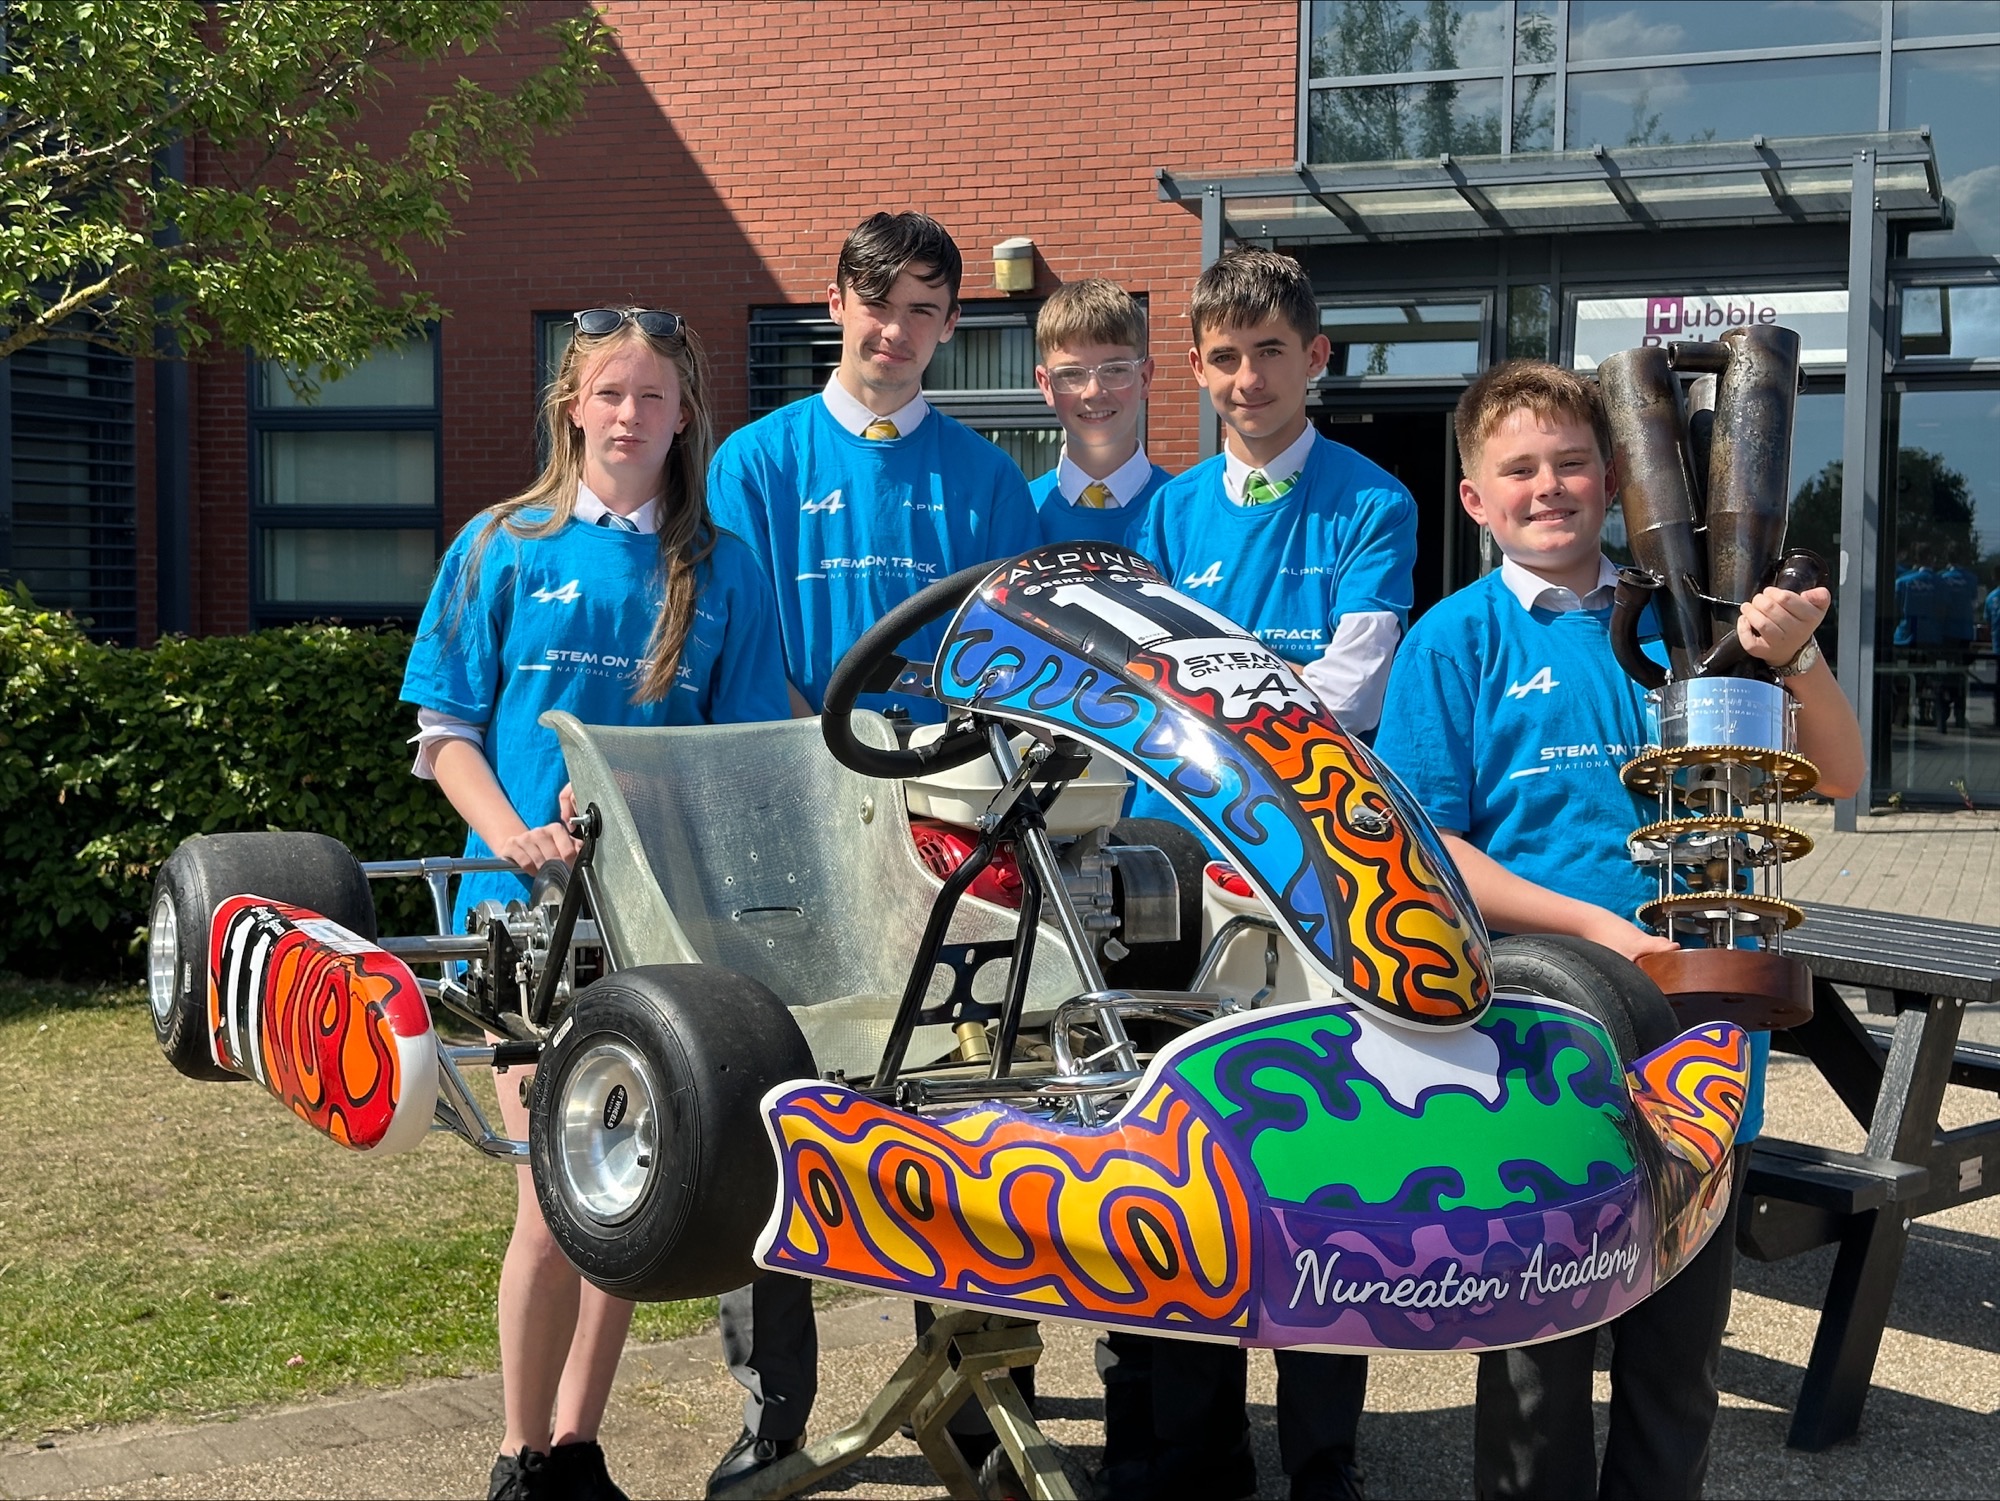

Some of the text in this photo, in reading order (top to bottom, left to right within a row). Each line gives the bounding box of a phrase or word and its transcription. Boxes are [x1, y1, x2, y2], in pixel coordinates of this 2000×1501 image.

[1653, 301, 1777, 330] Hubble
[820, 558, 865, 570] STEM
[864, 554, 888, 567] ON
[1008, 551, 1148, 585] ALPINE
[1280, 566, 1334, 576] ALPINE
[1264, 629, 1323, 641] TRACK
[545, 649, 598, 665] STEM
[602, 655, 630, 668] ON
[1183, 652, 1280, 671] STEM
[1191, 662, 1288, 678] ON TRACK
[1540, 743, 1598, 760] STEM
[1604, 745, 1628, 756] ON
[1555, 761, 1610, 771] NATIONA
[1289, 1232, 1640, 1309] Nuneaton Academy
